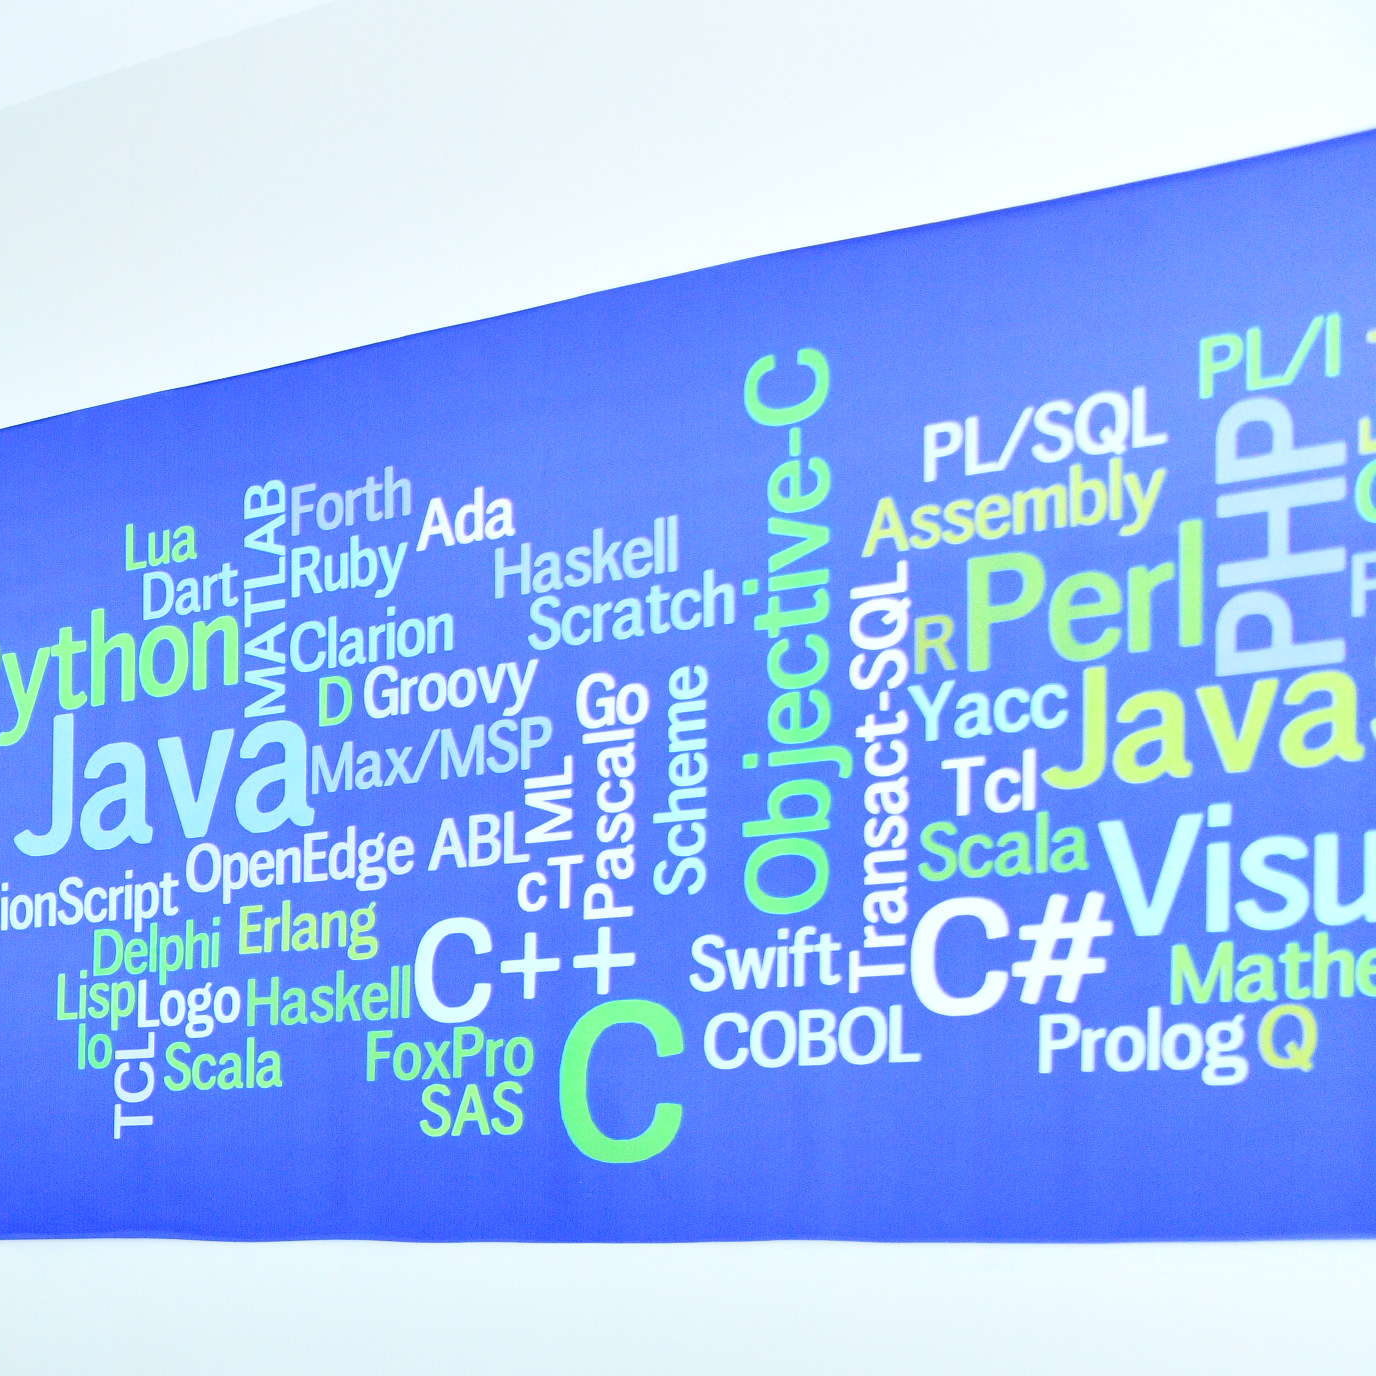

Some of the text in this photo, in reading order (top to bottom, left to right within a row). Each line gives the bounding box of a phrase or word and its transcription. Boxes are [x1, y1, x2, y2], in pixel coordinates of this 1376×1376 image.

[1199, 312, 1342, 399] PL/I
[923, 386, 1168, 482] PL/SQL
[291, 467, 411, 536] Forth
[416, 487, 515, 551] Ada
[861, 457, 1166, 557] Assembly
[126, 524, 197, 571] Lua
[291, 535, 408, 598] Ruby
[494, 515, 679, 599] Haskell
[1216, 397, 1346, 677] PHP
[143, 563, 238, 620] Dart
[244, 480, 286, 718] MATLAB
[528, 569, 735, 650] Scratch
[967, 518, 1203, 673] Perl
[290, 606, 453, 672] Clarion
[742, 347, 853, 915] Objective-C
[915, 615, 957, 674] R
[319, 675, 353, 727] D
[364, 659, 538, 719] Groovy
[576, 672, 650, 729] Go
[908, 680, 1068, 742] Yacc
[312, 716, 552, 794] Max/MSP
[1042, 666, 1376, 789] Java
[14, 713, 315, 858] Java
[524, 755, 573, 843] ML
[653, 665, 708, 895] Scheme
[849, 560, 911, 994] Transact-SQL
[942, 748, 1036, 816] Tcl
[186, 811, 531, 904] OpenEdge ABL
[582, 727, 636, 920] Pascal
[919, 811, 1089, 881] Scala
[518, 855, 583, 912] cT
[92, 916, 221, 986] Delphi
[239, 900, 379, 960] Erlang
[688, 926, 843, 992] Swift
[910, 891, 1110, 1017] C#
[57, 969, 136, 1031] Lisp
[247, 965, 411, 1027] Haskell
[414, 917, 636, 1023] C++
[137, 979, 241, 1039] Logo
[704, 1004, 921, 1070] COBOL
[1256, 1003, 1318, 1072] Q
[164, 1037, 284, 1092] Scala
[366, 1026, 534, 1082] FoxPro
[559, 998, 685, 1164] C
[1039, 1005, 1249, 1087] Prolog
[114, 1032, 156, 1139] TCL
[419, 1080, 524, 1138] SAS
